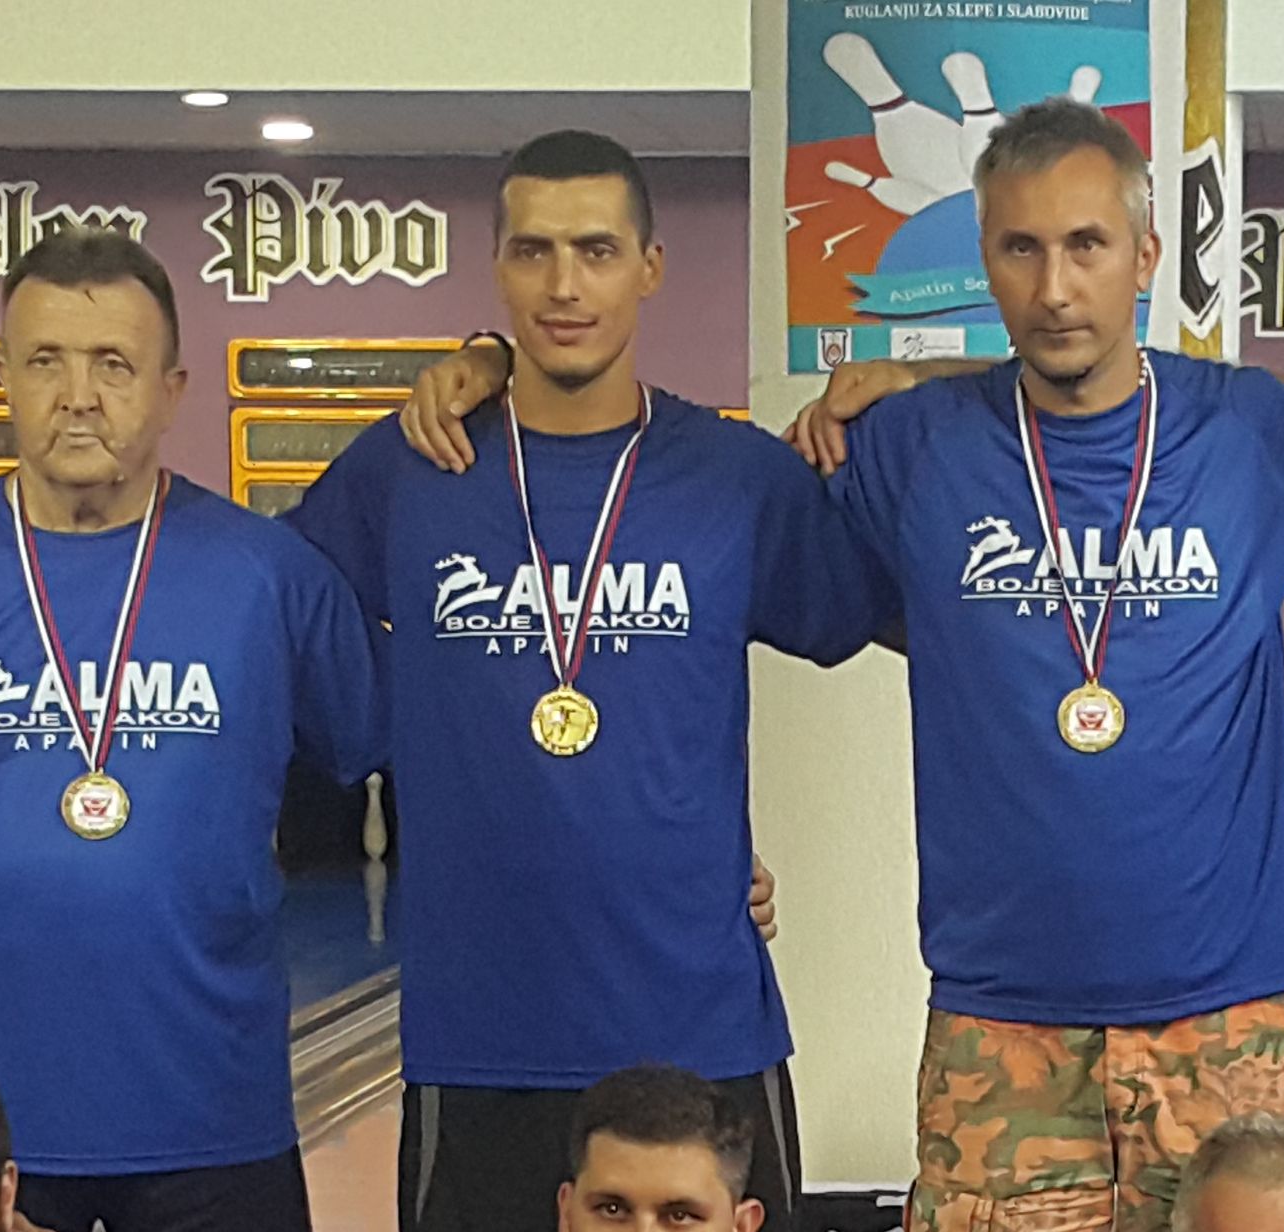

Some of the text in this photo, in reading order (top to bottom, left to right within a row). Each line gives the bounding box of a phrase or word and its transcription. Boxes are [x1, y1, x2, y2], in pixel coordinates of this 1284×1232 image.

[923, 5, 944, 17] ZA
[946, 5, 994, 18] SLEPE
[201, 172, 449, 302] Pivo
[889, 281, 954, 303] Apatin
[1034, 527, 1218, 580] ALMA
[502, 563, 690, 615] ALMA
[976, 578, 1063, 592] BOJE
[1094, 578, 1218, 594] LAKOVI
[1016, 600, 1159, 618] APAIN
[445, 615, 532, 631] BOJE
[486, 636, 629, 655] APAIN
[31, 660, 220, 712] ALMA
[15, 732, 157, 751] APAIN
